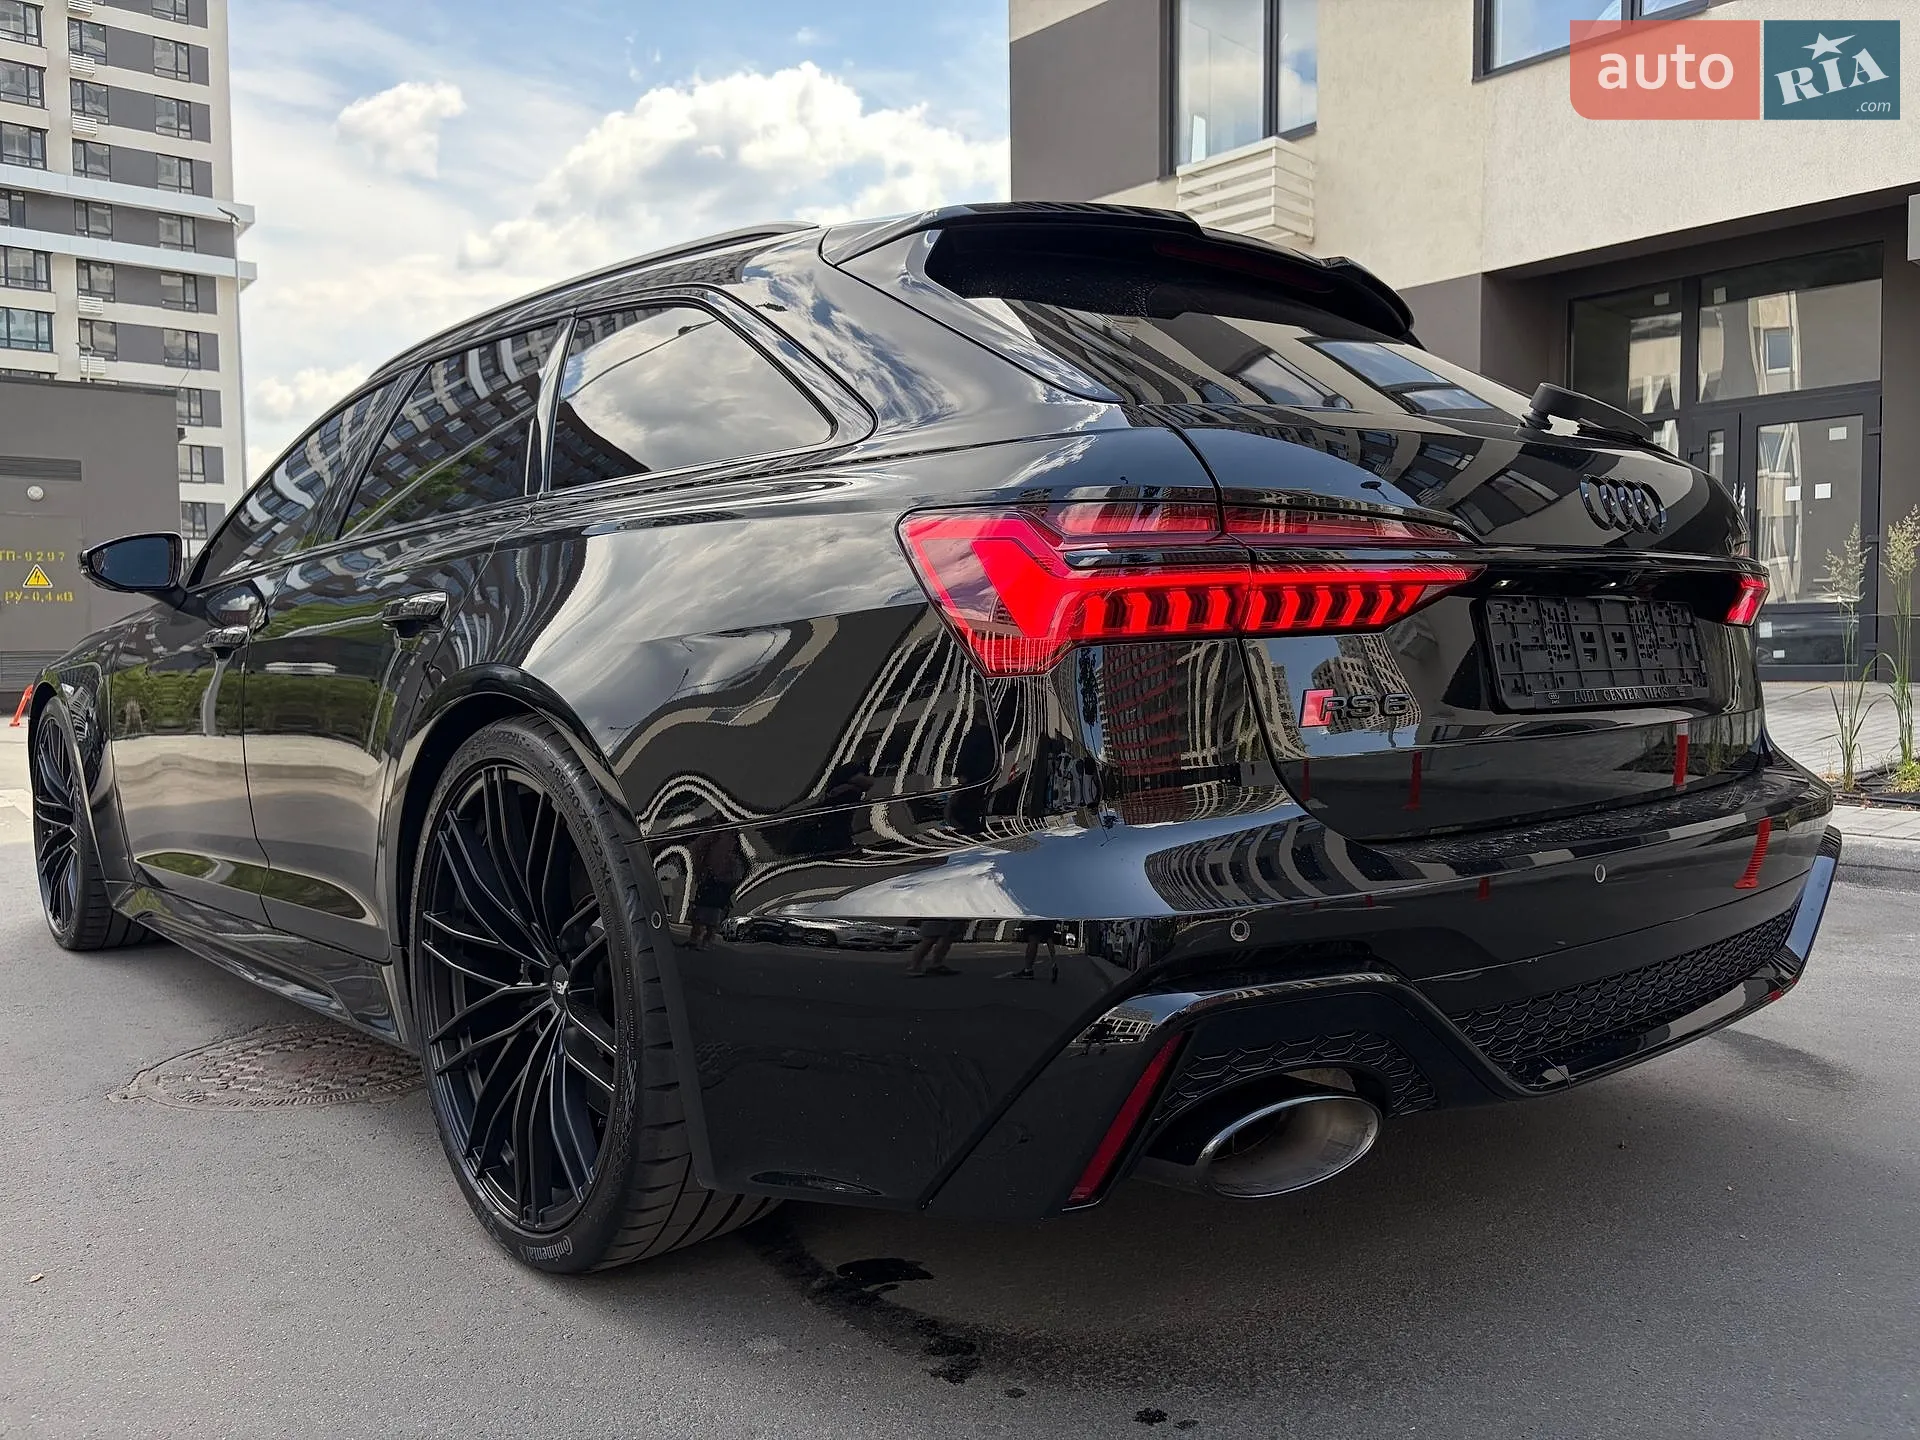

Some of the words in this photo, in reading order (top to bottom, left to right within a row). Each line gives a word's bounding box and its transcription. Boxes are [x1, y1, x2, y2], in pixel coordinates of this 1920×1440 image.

[1573, 688, 1600, 704] AUDI
[1603, 686, 1642, 702] CENTER
[1642, 685, 1671, 699] VIPOS
[526, 1235, 573, 1263] Continental
